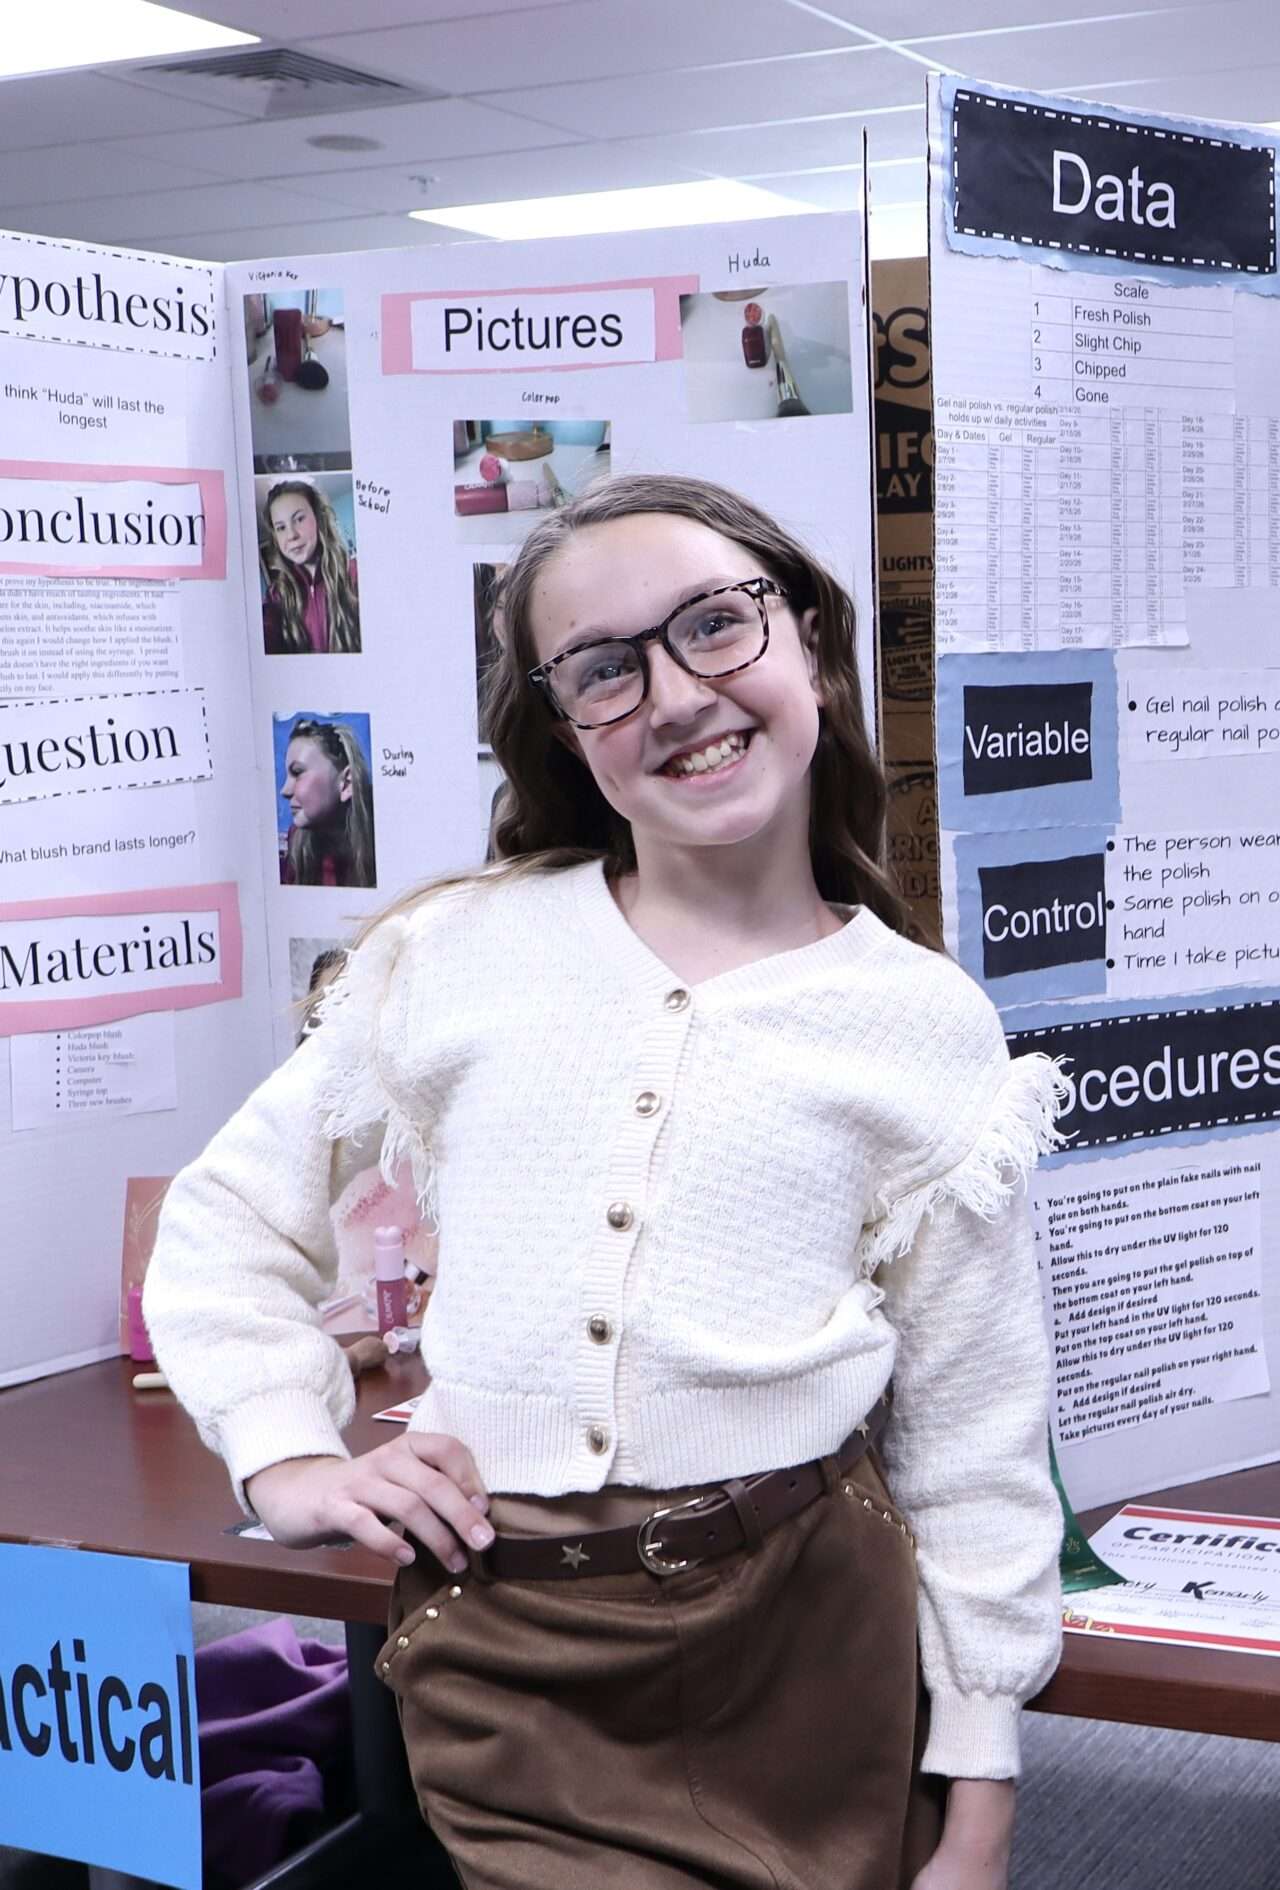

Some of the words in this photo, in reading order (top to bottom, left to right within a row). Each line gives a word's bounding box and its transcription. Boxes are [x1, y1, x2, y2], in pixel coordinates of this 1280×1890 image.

[1053, 150, 1177, 230] Data
[729, 248, 771, 273] Huda
[1113, 282, 1150, 300] Scale
[1033, 302, 1041, 316] 1
[1074, 305, 1110, 324] Fresh
[1112, 308, 1152, 327] Polish
[443, 308, 624, 353] Pictures
[1033, 330, 1041, 344] 2
[1075, 333, 1110, 353] Slight
[1112, 336, 1142, 355] Chip
[1033, 357, 1042, 372] 3
[1075, 360, 1127, 379] Chipped
[4, 383, 39, 401] think
[92, 395, 114, 410] will
[117, 398, 141, 412] last
[144, 401, 165, 415] the
[1033, 385, 1042, 399] 4
[1075, 387, 1110, 404] Gone
[59, 411, 108, 430] longest
[937, 399, 951, 410] Gel
[952, 399, 967, 410] nail
[968, 401, 992, 414] polish
[1006, 404, 1034, 416] regular
[1035, 406, 1058, 418] polish
[937, 429, 953, 441] Day
[963, 430, 986, 441] Dates
[999, 432, 1013, 442] Gel
[1026, 434, 1057, 446] Regular
[355, 479, 391, 498] Before
[357, 494, 391, 514] School
[1146, 696, 1175, 714] Gel
[1182, 693, 1211, 714] nail
[1217, 695, 1268, 721] polish
[966, 721, 1090, 760] Variable
[1146, 729, 1214, 752] regular
[1222, 724, 1250, 742] nail
[0, 718, 181, 788] uestion
[382, 748, 415, 765] During
[31, 845, 68, 861] blush
[72, 839, 111, 857] brand
[115, 837, 146, 852] lasts
[149, 830, 197, 849] longer?
[1123, 837, 1157, 853] The
[1164, 836, 1232, 859] person
[1123, 865, 1153, 882] the
[1160, 863, 1211, 888] polish
[1123, 894, 1175, 912] Same
[1182, 890, 1232, 915] polish
[1239, 891, 1261, 905] on
[983, 890, 1105, 942] Control
[1123, 918, 1166, 942] hand
[0, 920, 216, 989] Materials
[1123, 952, 1168, 970] Time
[1186, 947, 1227, 965] take
[1077, 1190, 1101, 1204] going
[1102, 1188, 1112, 1198] to
[1113, 1186, 1128, 1197] put
[1129, 1184, 1141, 1193] on
[1142, 1180, 1156, 1191] the
[1157, 1176, 1180, 1190] plain
[1180, 1174, 1199, 1185] fake
[1200, 1168, 1222, 1181] nails
[1222, 1165, 1243, 1177] with
[1243, 1162, 1262, 1174] nail
[1112, 1541, 1133, 1550] OF
[1137, 1542, 1267, 1562] PARTICIPATION
[0, 1638, 193, 1786] ctical
